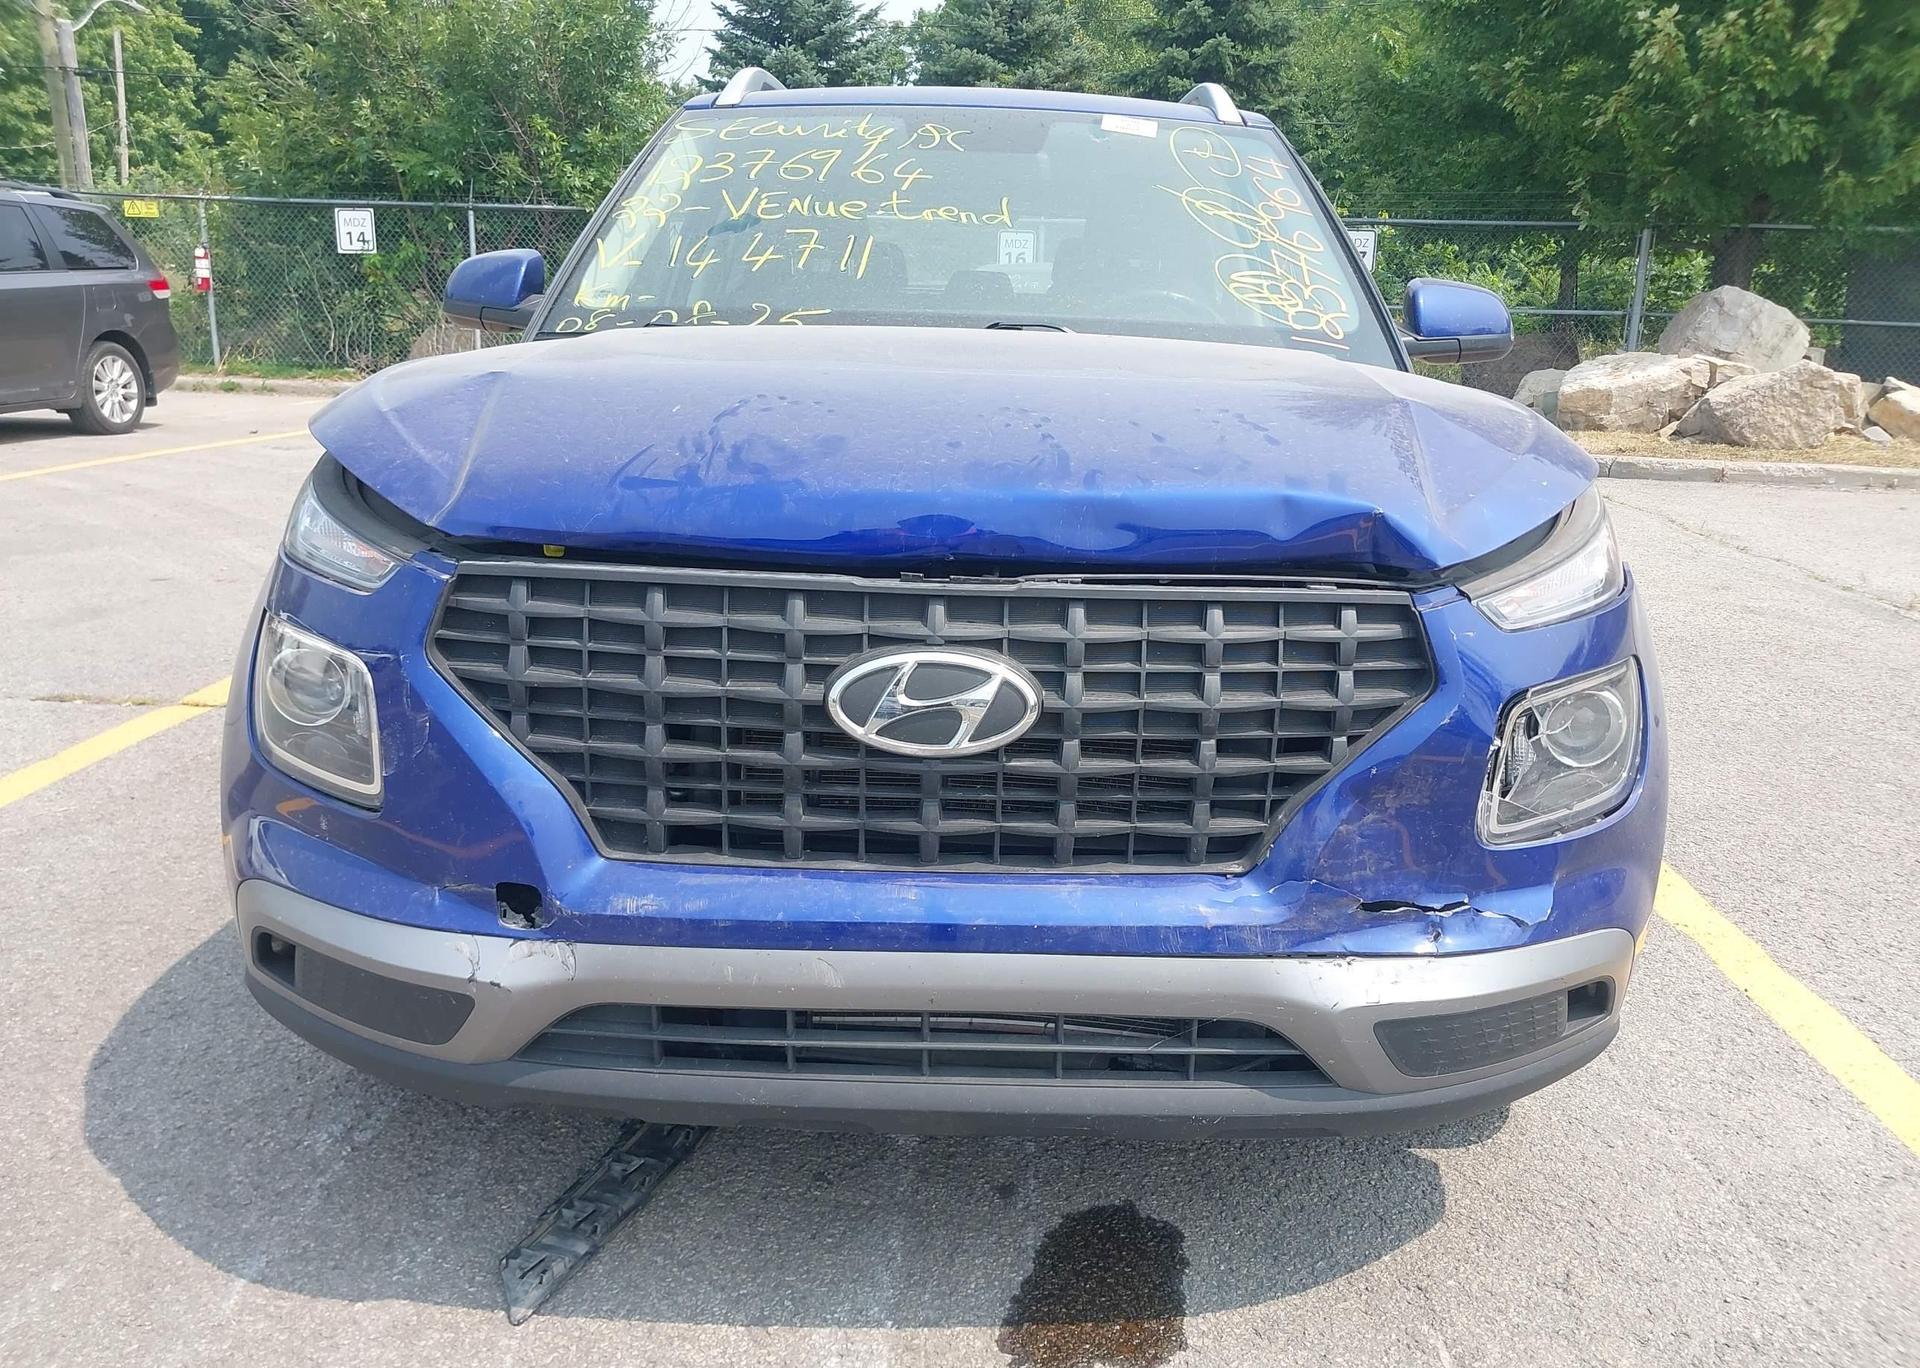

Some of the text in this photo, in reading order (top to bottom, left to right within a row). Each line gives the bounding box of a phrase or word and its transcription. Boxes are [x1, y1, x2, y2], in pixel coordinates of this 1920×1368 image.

[343, 217, 367, 228] MDZ
[346, 231, 367, 246] 14
[1005, 239, 1029, 249] MDZ
